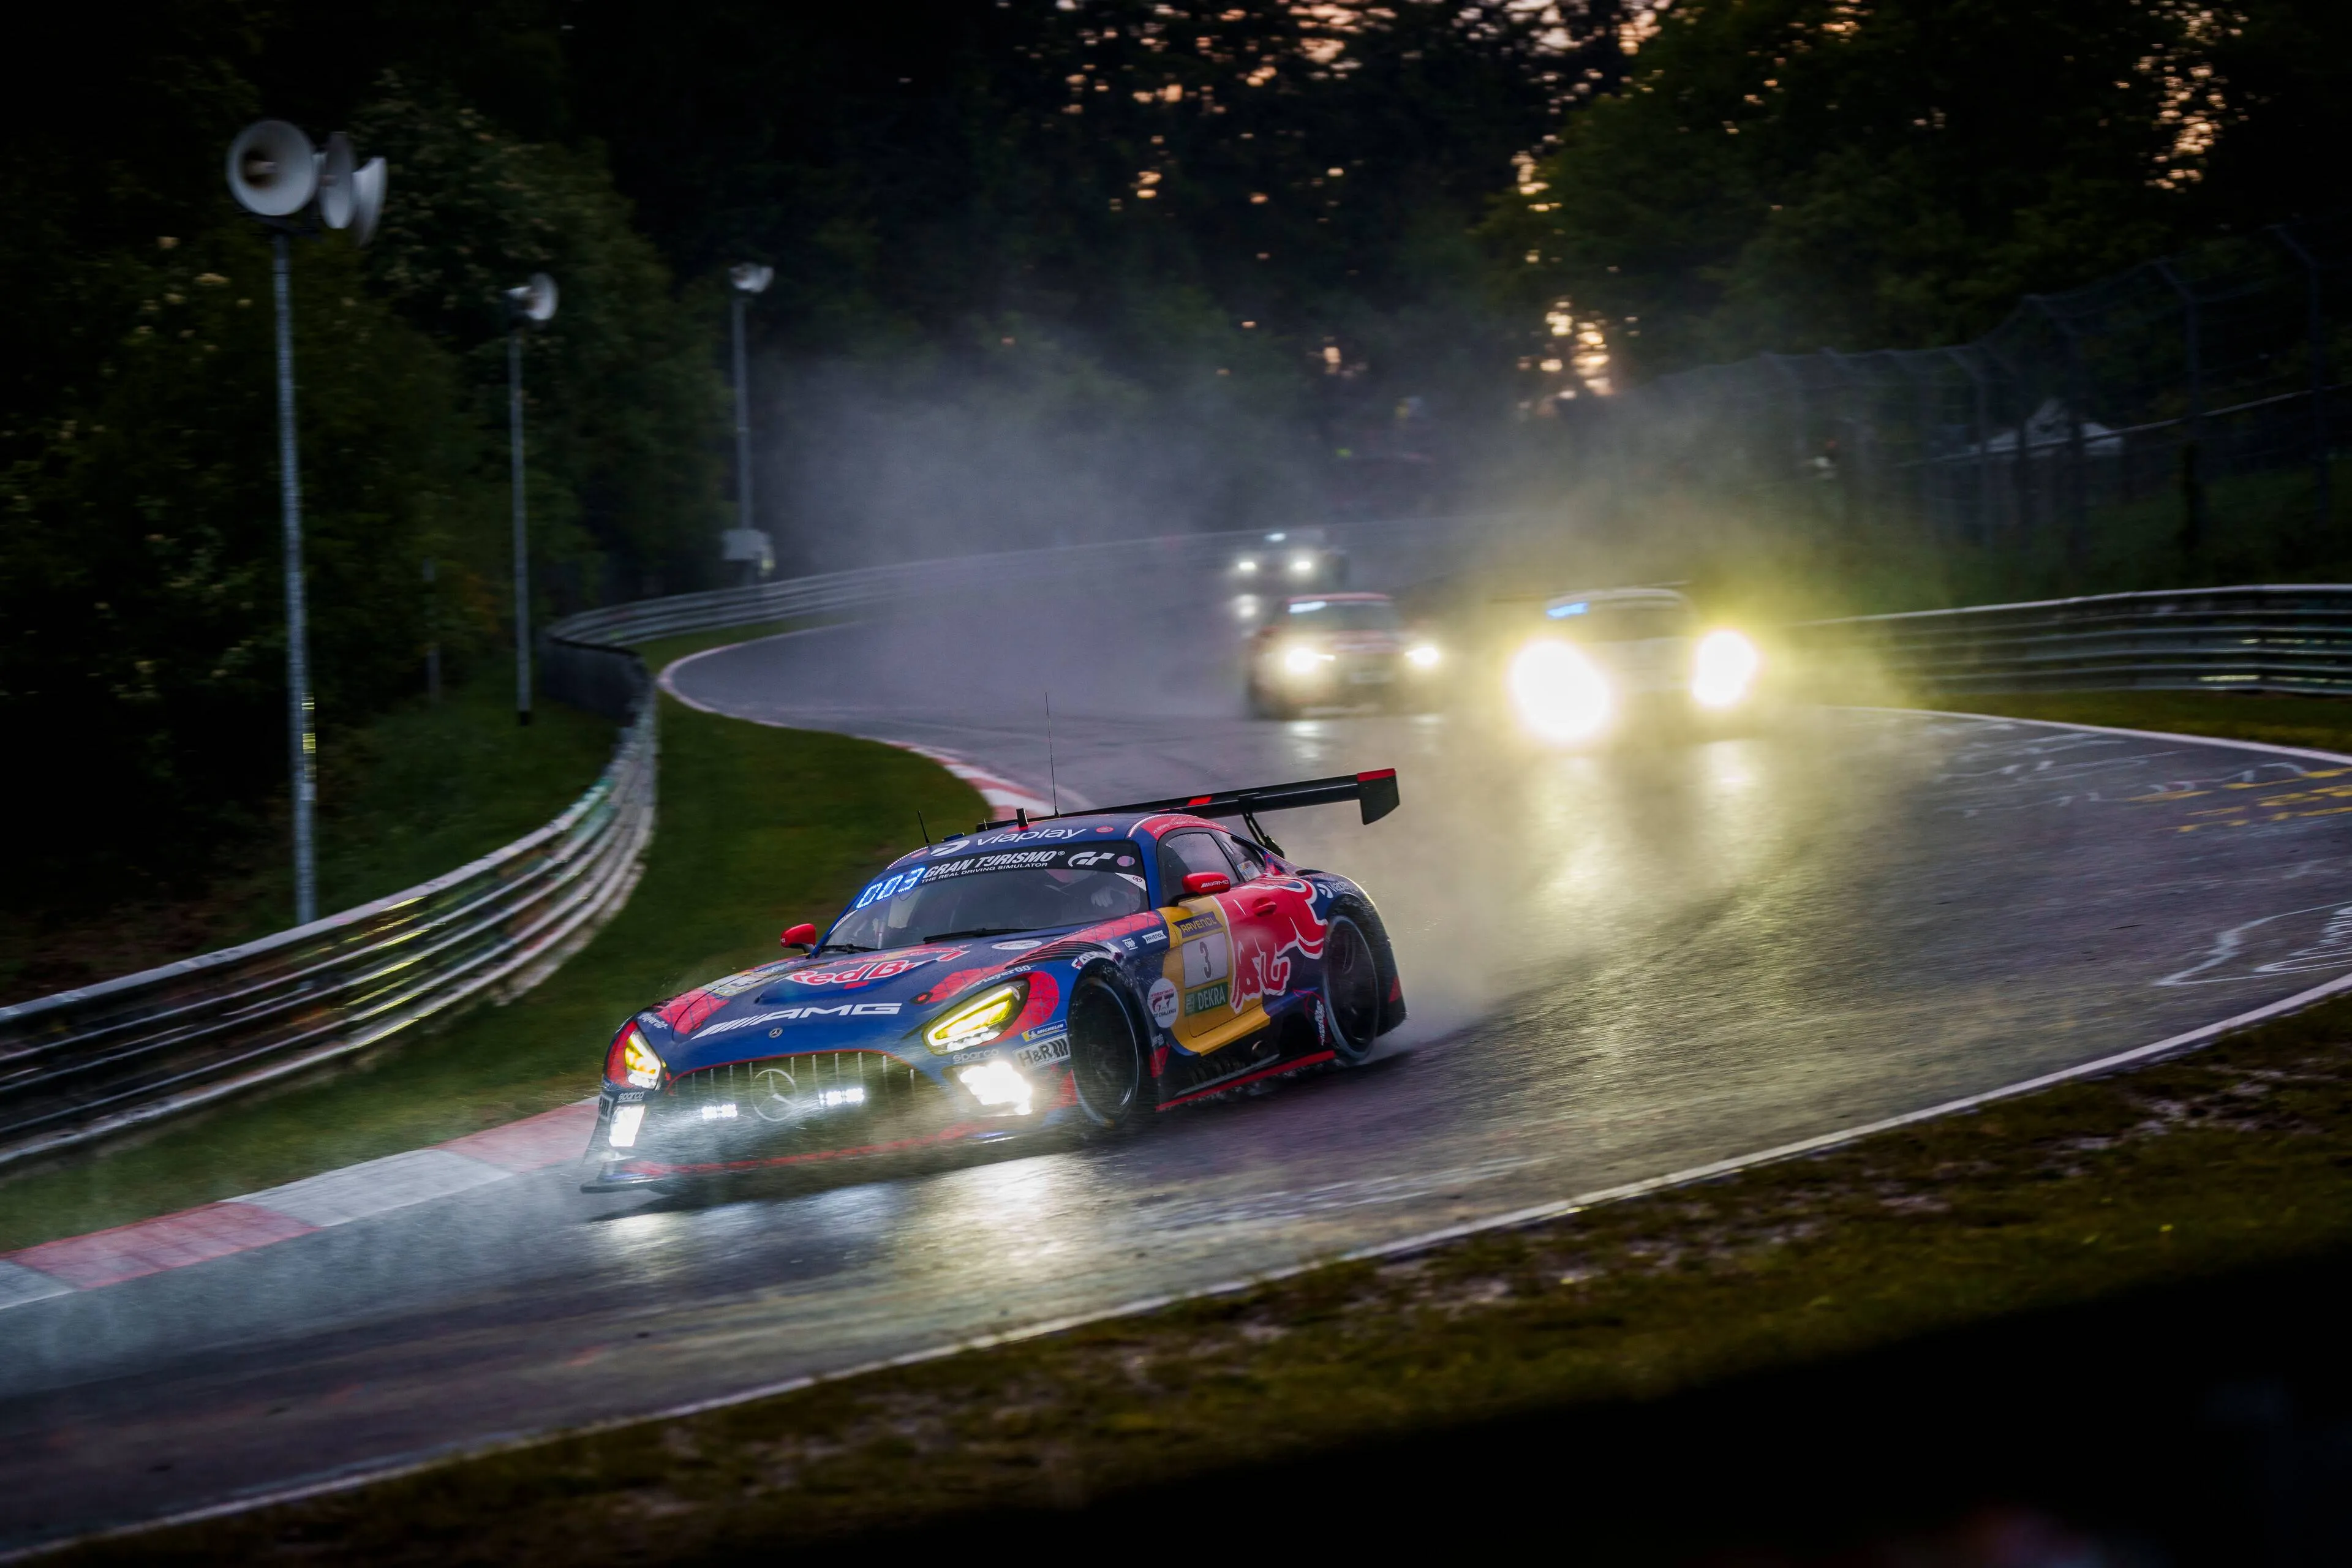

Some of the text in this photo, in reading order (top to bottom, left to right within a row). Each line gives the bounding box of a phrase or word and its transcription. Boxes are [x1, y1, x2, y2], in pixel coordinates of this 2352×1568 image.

[977, 828, 1087, 846] viaplay
[923, 858, 976, 879] GRAN
[938, 871, 959, 880] REAL
[961, 865, 996, 875] DRIVING
[997, 862, 1048, 870] SIMULATOR
[856, 867, 925, 909] 003
[1180, 916, 1218, 933] RAVENOL
[1146, 933, 1165, 942] RAVENOL
[1199, 941, 1212, 979] 3
[1198, 985, 1226, 1011] DEKRA
[1036, 1023, 1065, 1035] MICHELIN
[952, 1049, 1000, 1064] sparco
[1017, 1043, 1054, 1067] H&R
[617, 1091, 646, 1101] sparco
